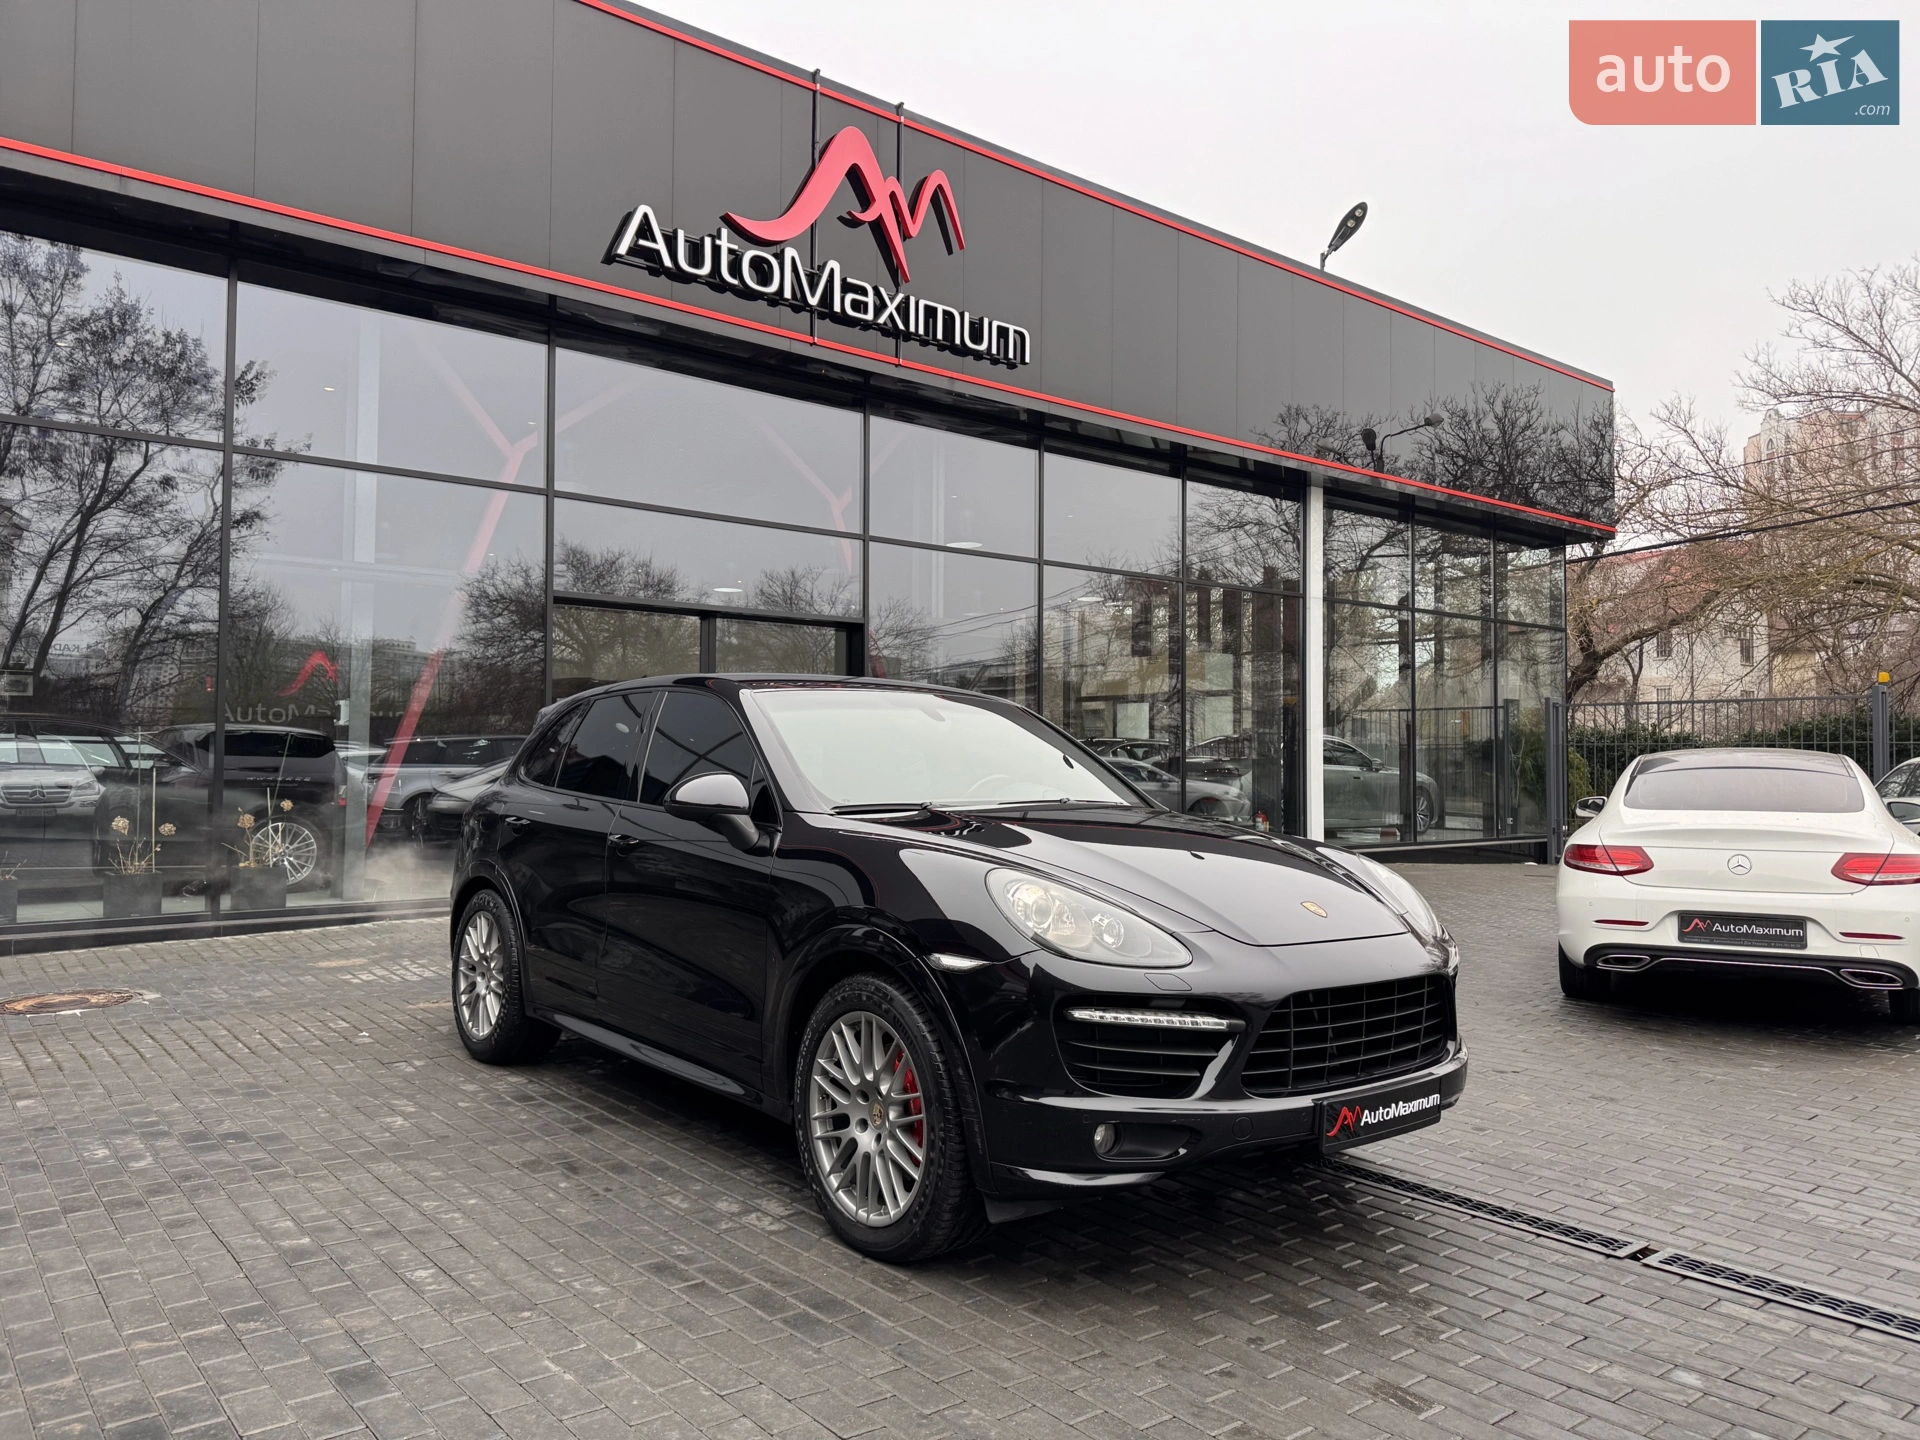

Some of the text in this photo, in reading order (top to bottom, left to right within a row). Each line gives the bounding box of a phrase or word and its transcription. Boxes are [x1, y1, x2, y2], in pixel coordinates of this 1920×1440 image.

[613, 204, 1030, 365] AutoMaximum
[1712, 923, 1804, 937] AutoMaximum
[1360, 1094, 1441, 1127] AutoMaximum
